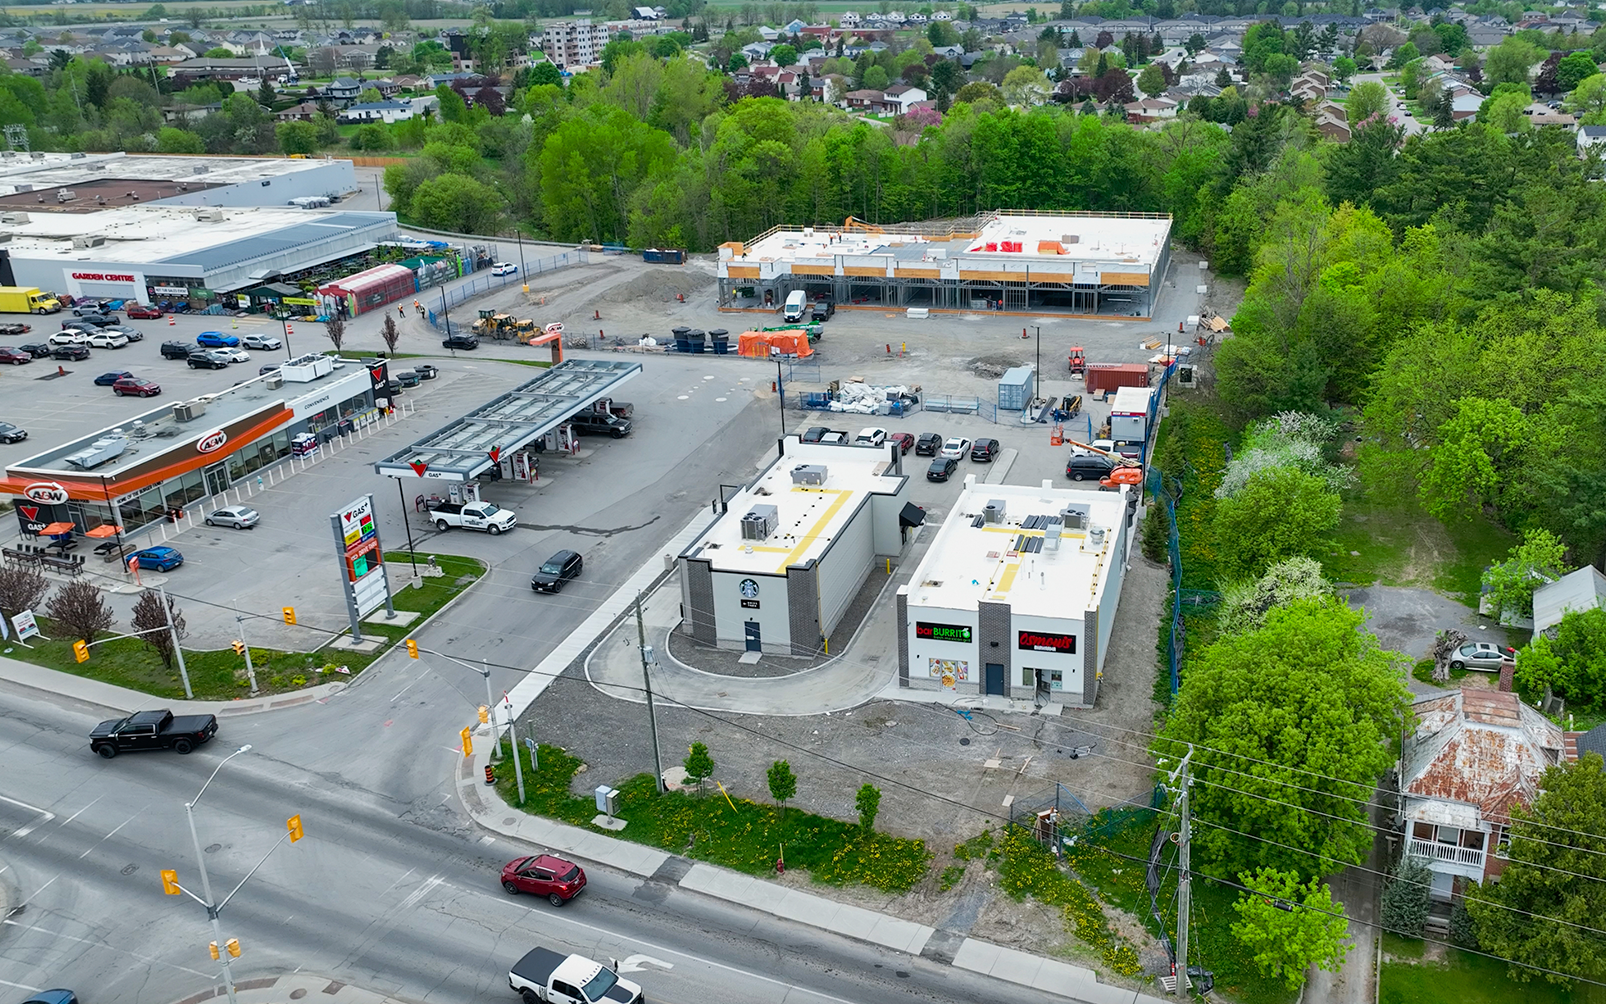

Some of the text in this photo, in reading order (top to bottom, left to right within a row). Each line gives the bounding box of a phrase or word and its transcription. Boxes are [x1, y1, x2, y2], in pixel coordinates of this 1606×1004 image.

[72, 272, 135, 283] GARDEN CENTRE
[304, 395, 330, 410] CONVENIENCE
[203, 435, 225, 451] A&W
[32, 490, 63, 502] A&W
[353, 502, 369, 519] GAS+
